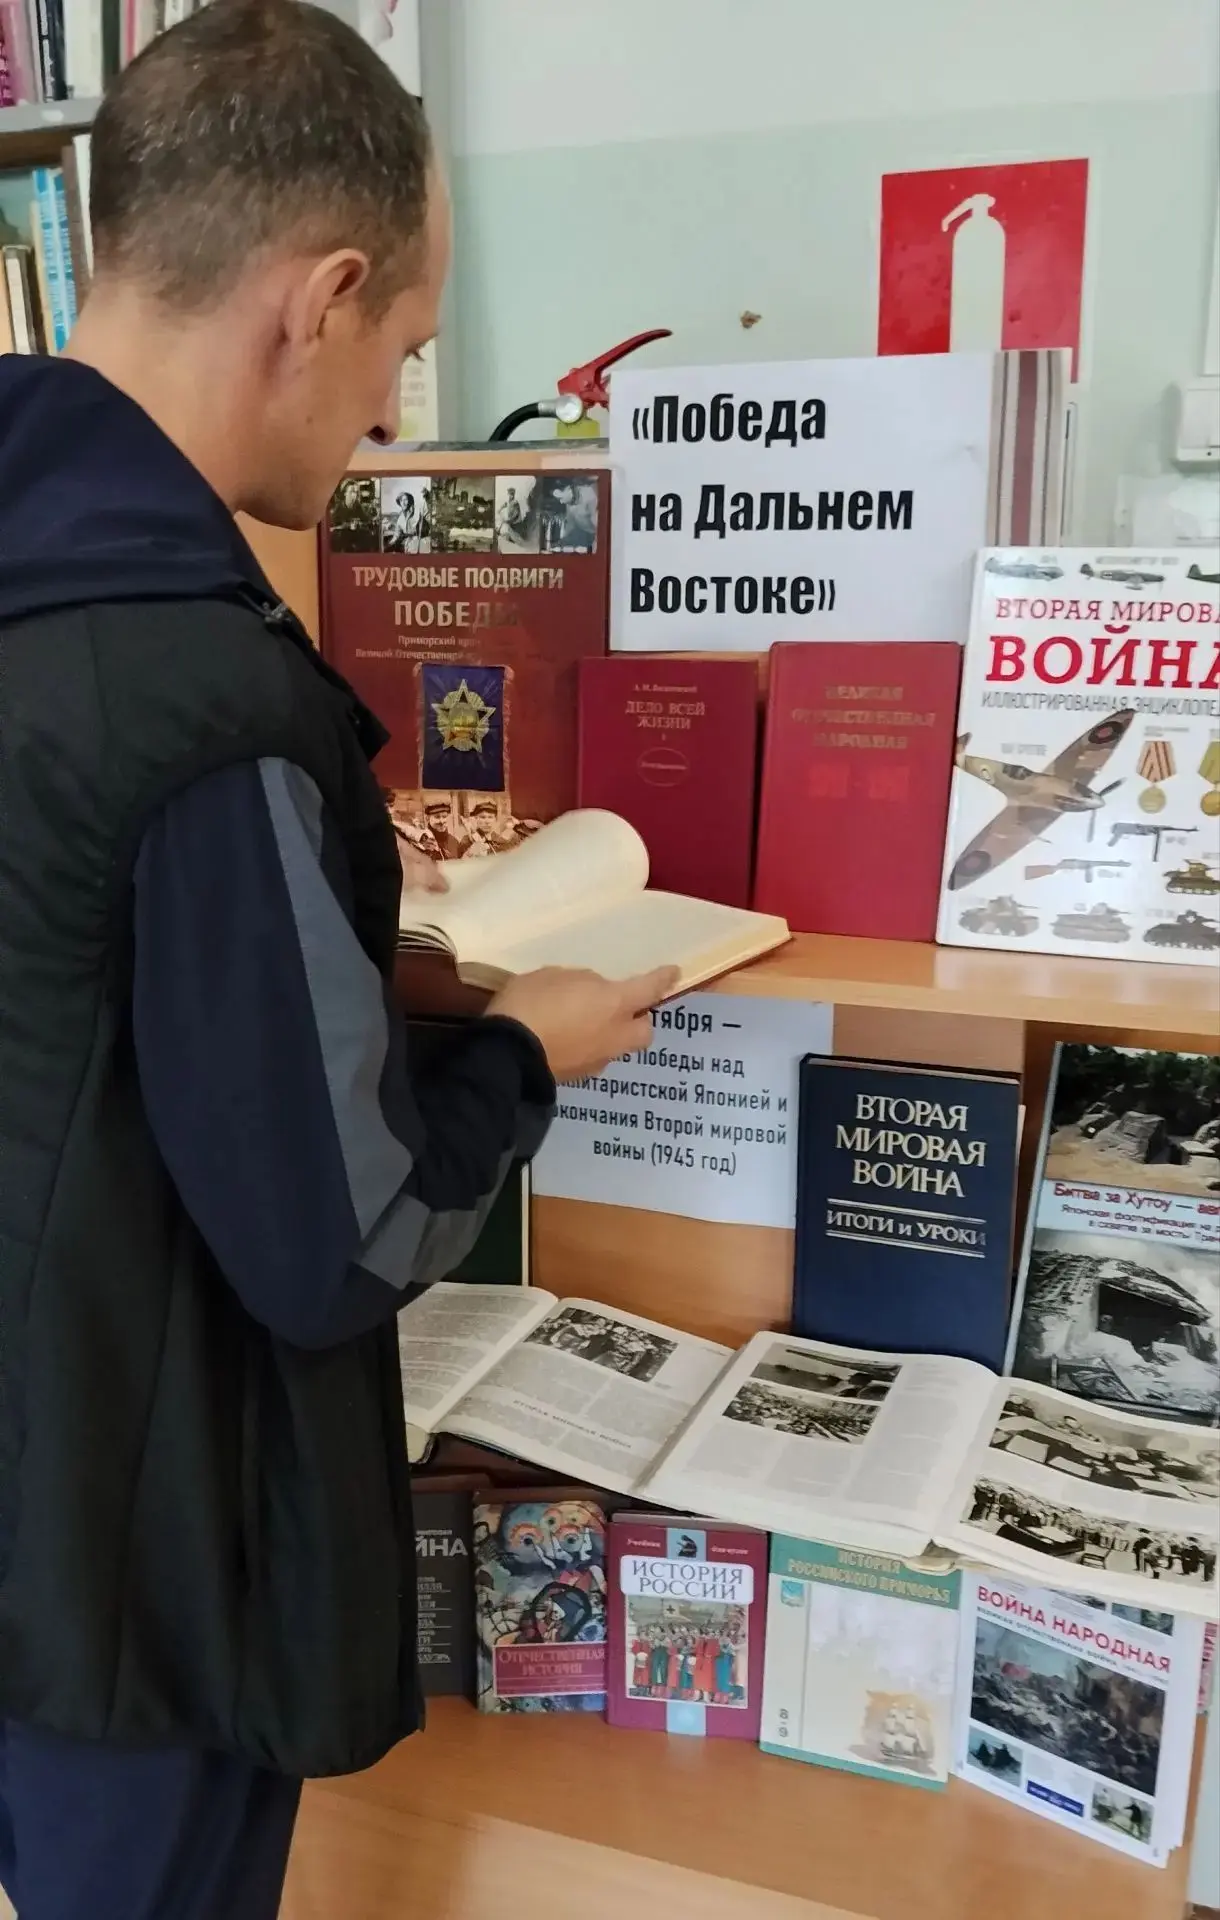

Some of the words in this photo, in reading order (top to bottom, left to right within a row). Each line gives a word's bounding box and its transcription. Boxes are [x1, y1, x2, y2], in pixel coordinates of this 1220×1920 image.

[632, 393, 826, 448] «Победа
[631, 493, 682, 531] на
[694, 484, 914, 539] Дальнем
[352, 567, 459, 592] ТРУДОВЫЕ
[465, 567, 563, 592] ПОДВИГИ
[630, 568, 836, 614] Востоке»
[995, 598, 1102, 620] ВТОРАЯ
[1110, 600, 1220, 624] МИРОВ
[625, 701, 663, 714] ДЕЛО
[669, 702, 706, 716] ВСЕЙ
[637, 716, 692, 729] ЖИЗНИ
[711, 1057, 745, 1079] над
[694, 1083, 771, 1111] Японией
[778, 1096, 788, 1112] и
[855, 1094, 969, 1132] ВТОРАЯ
[644, 1110, 704, 1138] Второй
[710, 1122, 787, 1146] мировой
[593, 1137, 645, 1161] войны
[651, 1141, 694, 1168] (1945
[701, 1151, 737, 1176] год)
[836, 1124, 988, 1167] МИРОВАЯ
[852, 1158, 966, 1198] ВОЙНА
[1054, 1182, 1100, 1201] Битва
[1104, 1192, 1121, 1204] за
[1125, 1191, 1173, 1213] Хутоу
[826, 1209, 894, 1234] ИТОГИ
[898, 1222, 912, 1236] и
[916, 1222, 987, 1246] УРОКИ
[633, 1560, 743, 1584] ИСТОРИЯ
[838, 1550, 900, 1574] ИСТОРИЯ
[640, 1577, 736, 1600] РОССИИ
[977, 1585, 1046, 1627] ВОЙНА
[1052, 1615, 1171, 1674] НАРОДНАЯ
